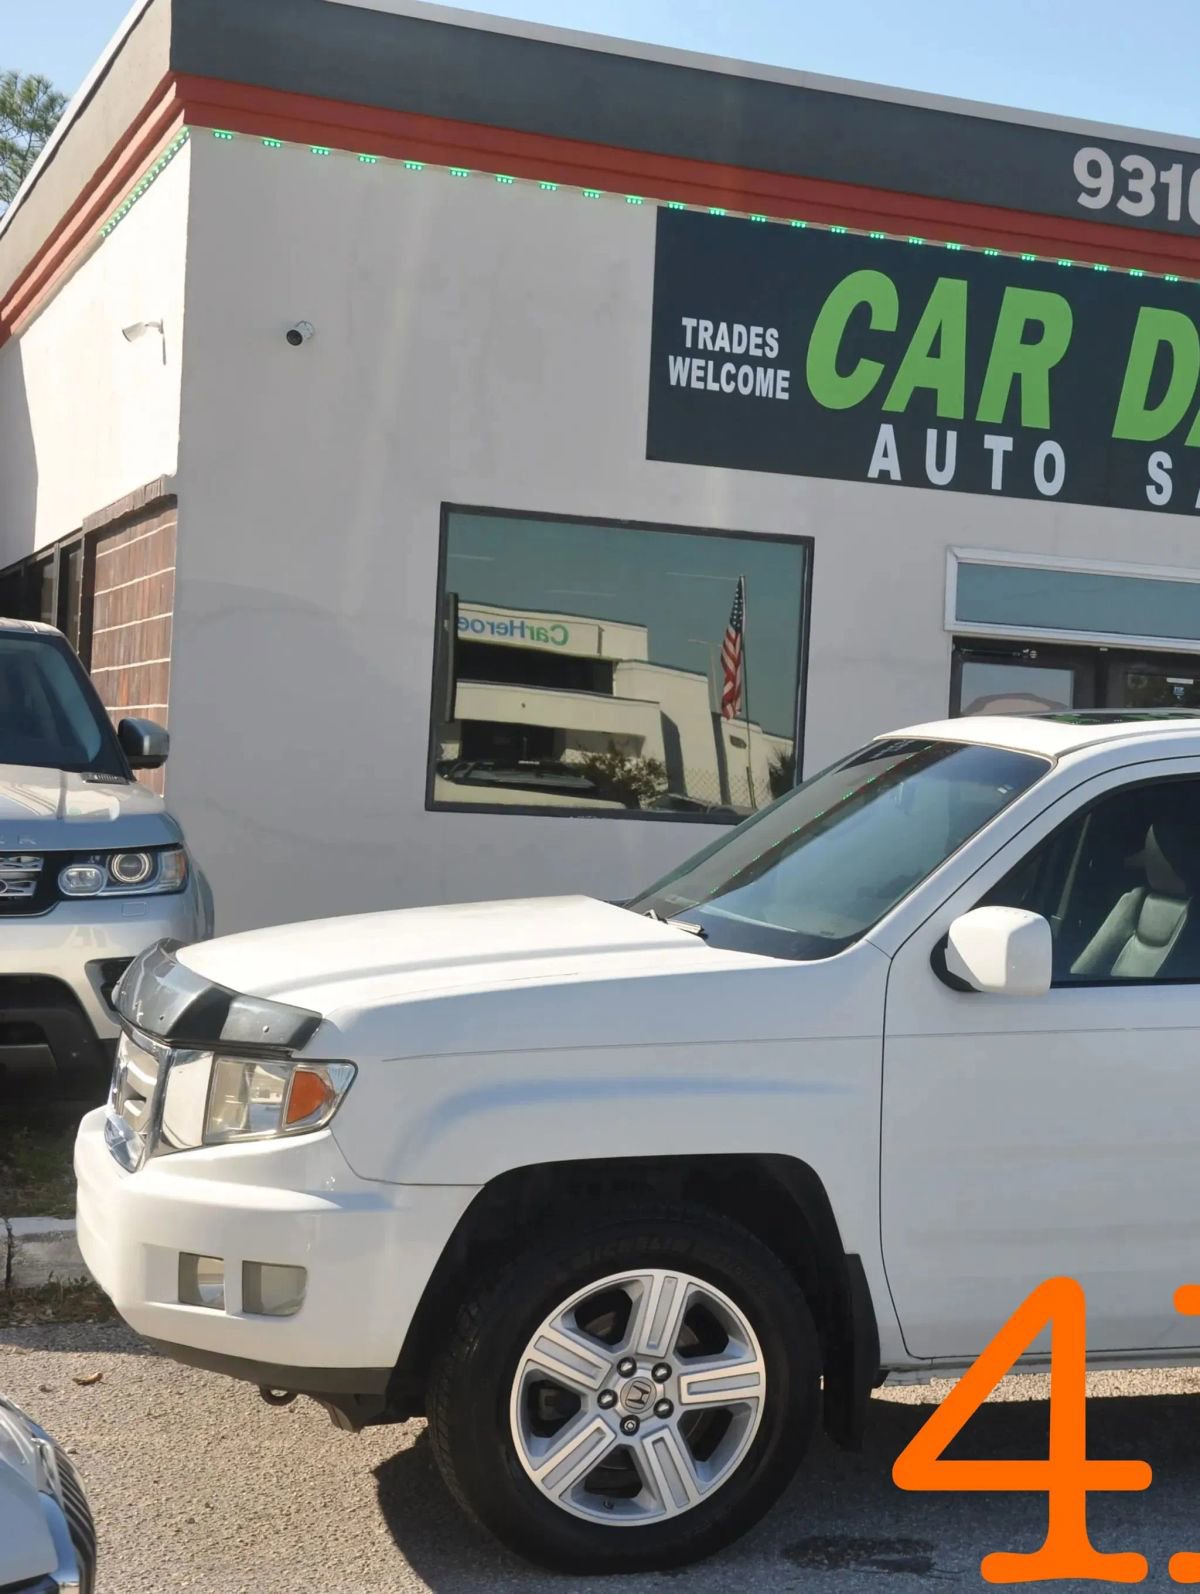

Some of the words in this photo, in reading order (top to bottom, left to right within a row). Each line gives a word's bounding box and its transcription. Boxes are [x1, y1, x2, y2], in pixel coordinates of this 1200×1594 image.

[681, 316, 779, 359] TRADES
[806, 270, 1074, 429] CAR
[667, 354, 791, 400] WELCOME
[867, 423, 1067, 497] AUTO
